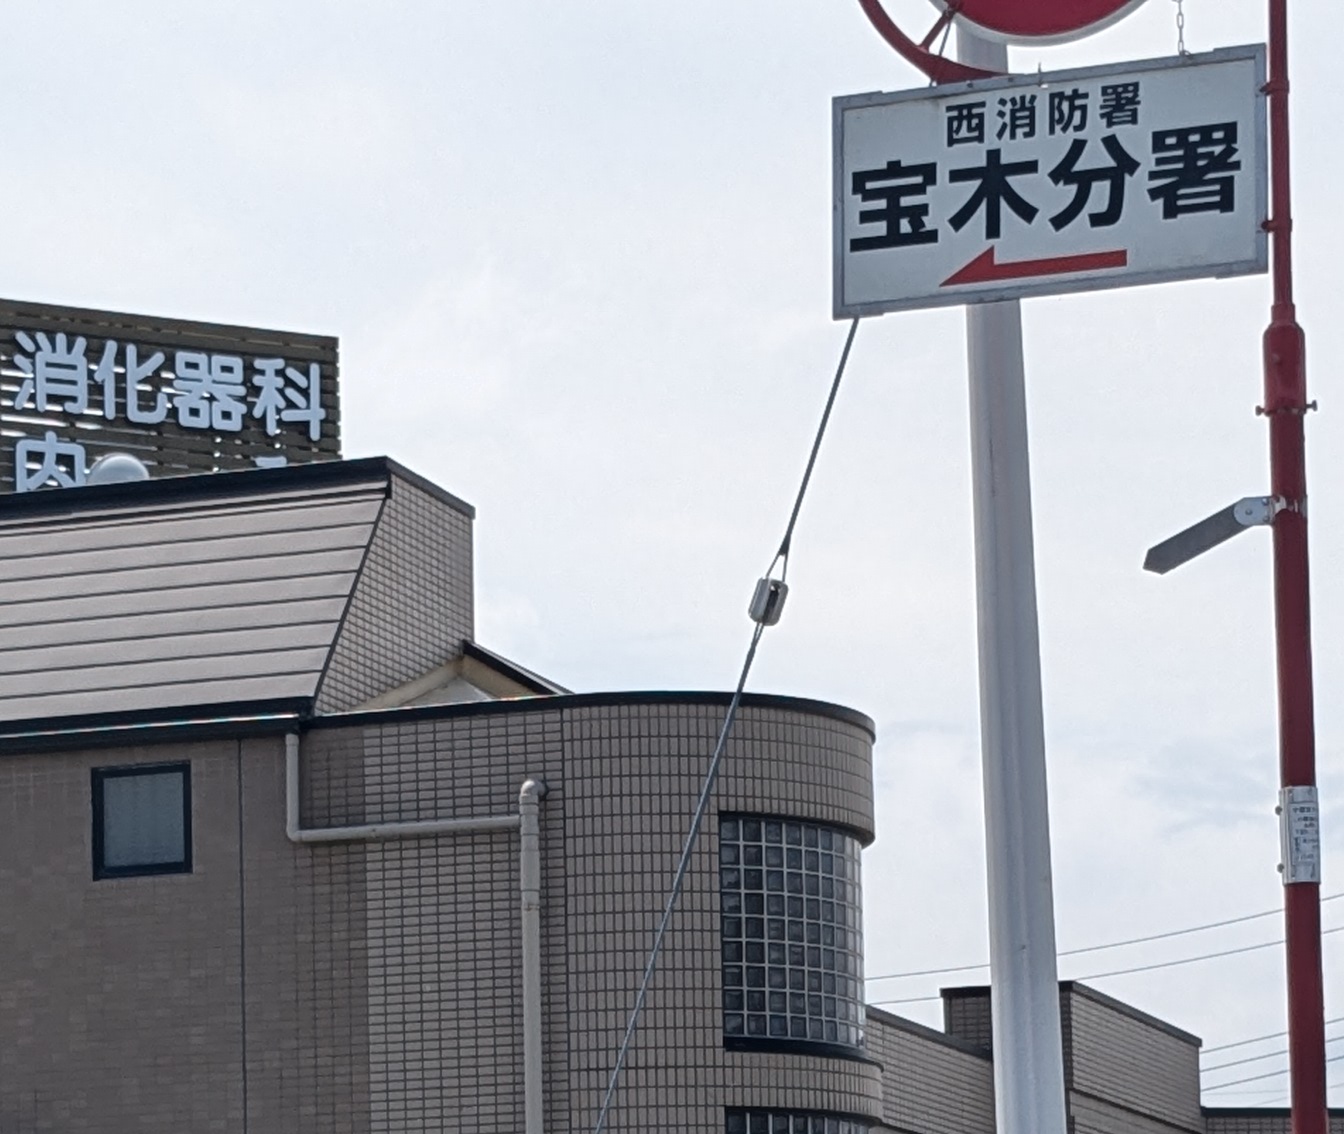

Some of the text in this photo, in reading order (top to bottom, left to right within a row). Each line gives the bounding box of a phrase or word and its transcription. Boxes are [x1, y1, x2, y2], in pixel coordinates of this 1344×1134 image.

[946, 81, 1141, 147] 西消防署
[849, 121, 1242, 252] 宝木分署
[14, 329, 326, 442] 消化器科
